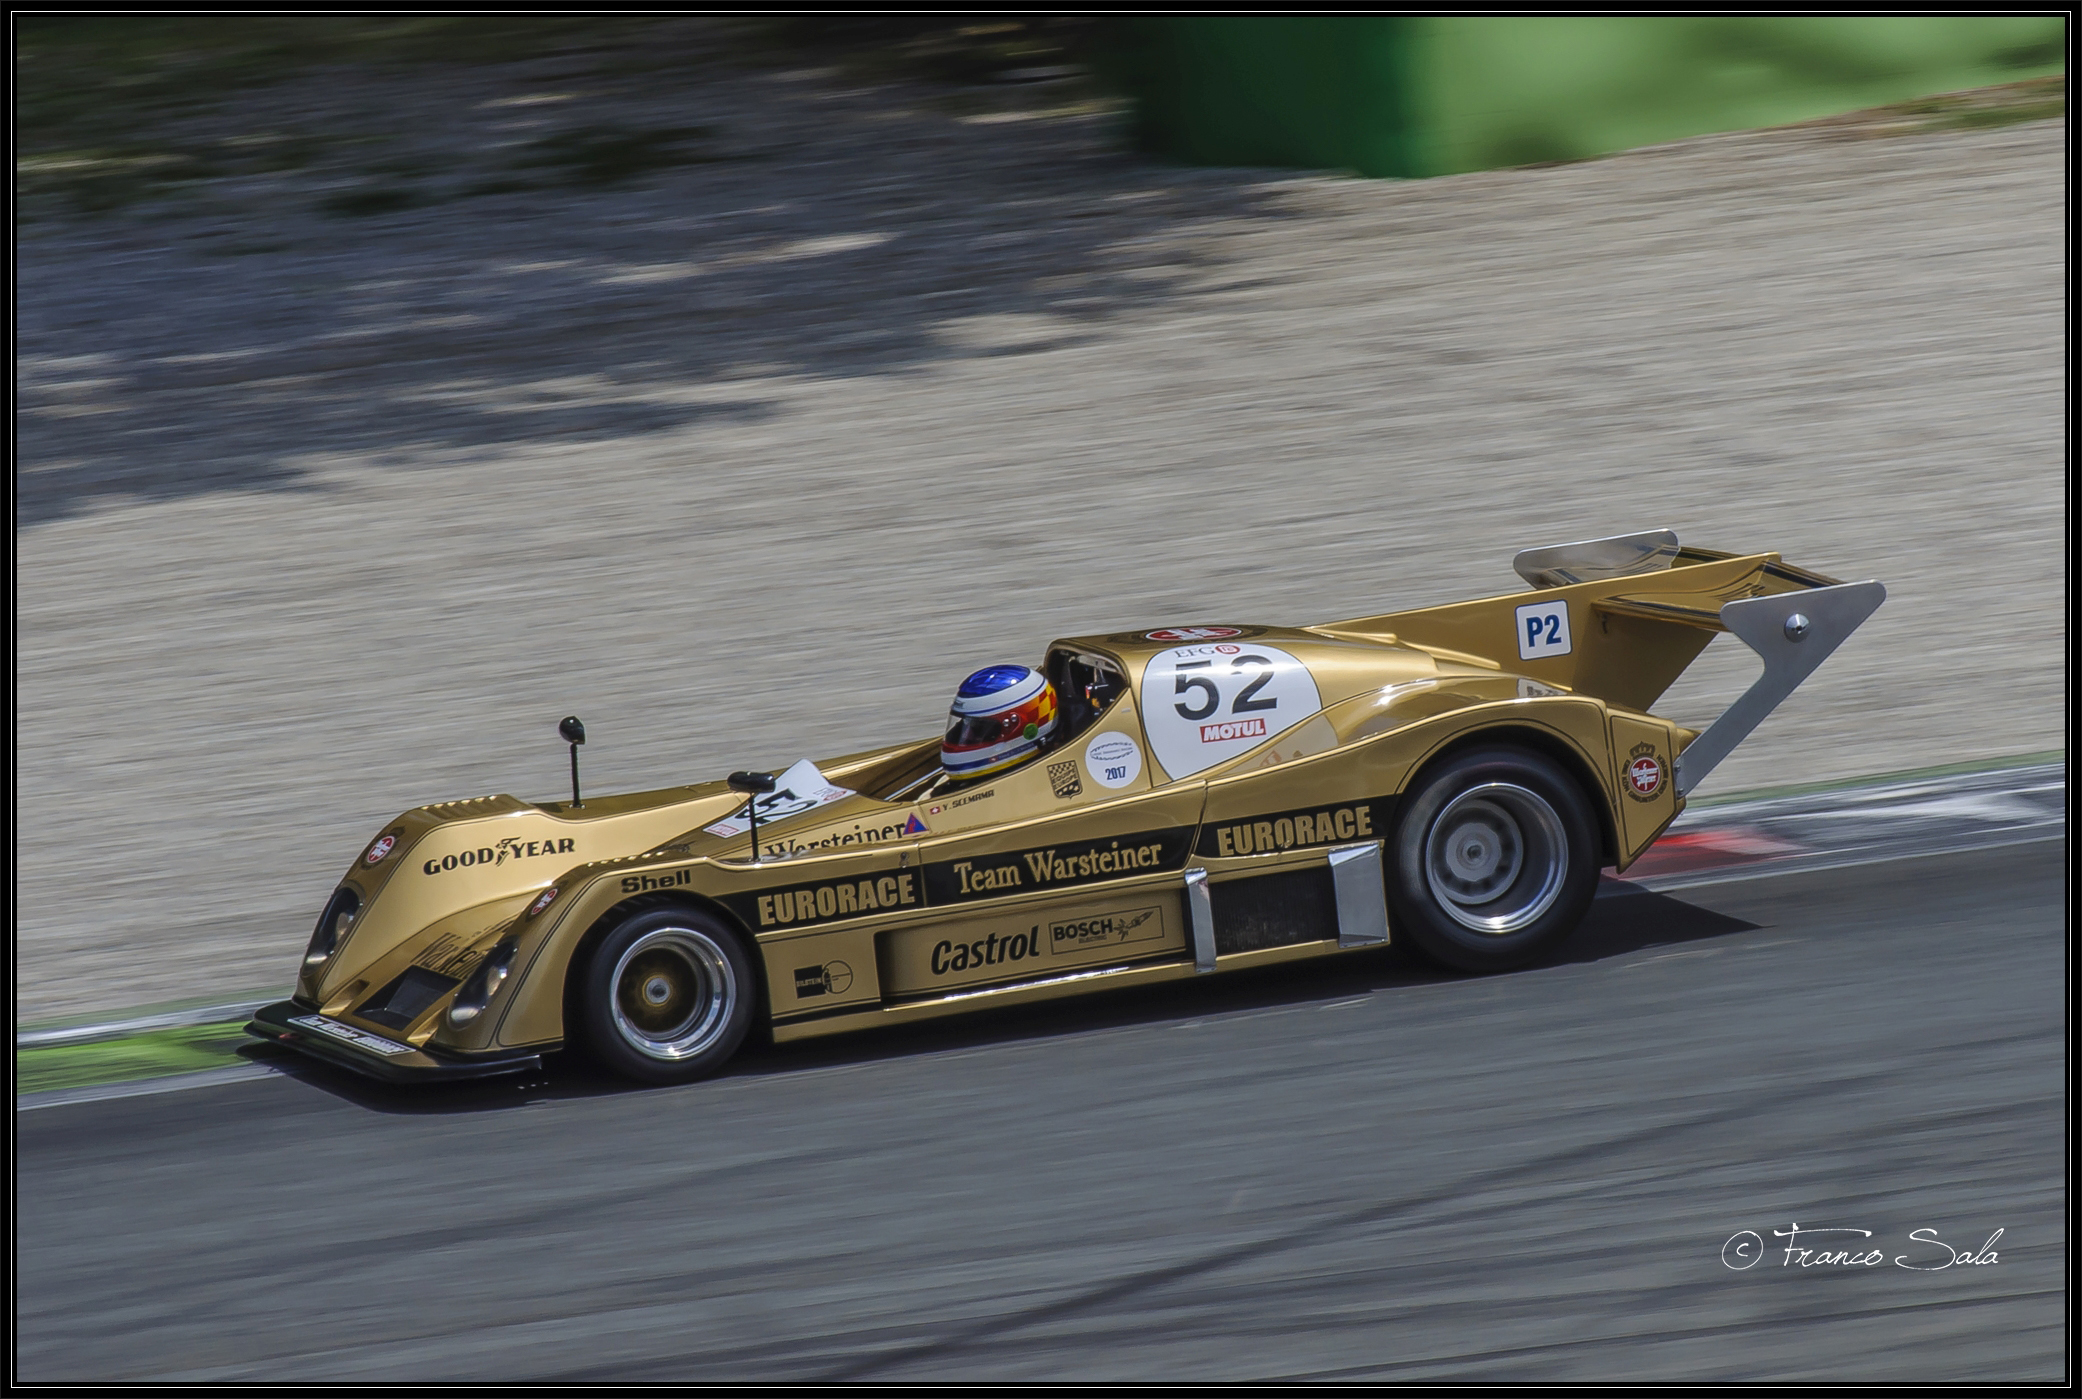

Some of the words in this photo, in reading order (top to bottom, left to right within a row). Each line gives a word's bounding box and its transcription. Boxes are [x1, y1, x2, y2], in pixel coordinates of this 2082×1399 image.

[1526, 614, 1562, 648] P2
[1175, 647, 1215, 658] EFG
[1174, 654, 1277, 721] 52
[1203, 719, 1264, 742] MOTUL
[1105, 765, 1126, 780] 2017
[1216, 805, 1373, 857] EURORACE
[423, 847, 494, 876] GOOD
[509, 838, 575, 859] YEAR
[953, 861, 1022, 894] Team
[1024, 841, 1162, 883] Warsteiner
[621, 869, 691, 894] Shell
[757, 873, 915, 926] EURORACE
[1053, 918, 1114, 942] BOSCH
[930, 924, 1040, 976] Castrol
